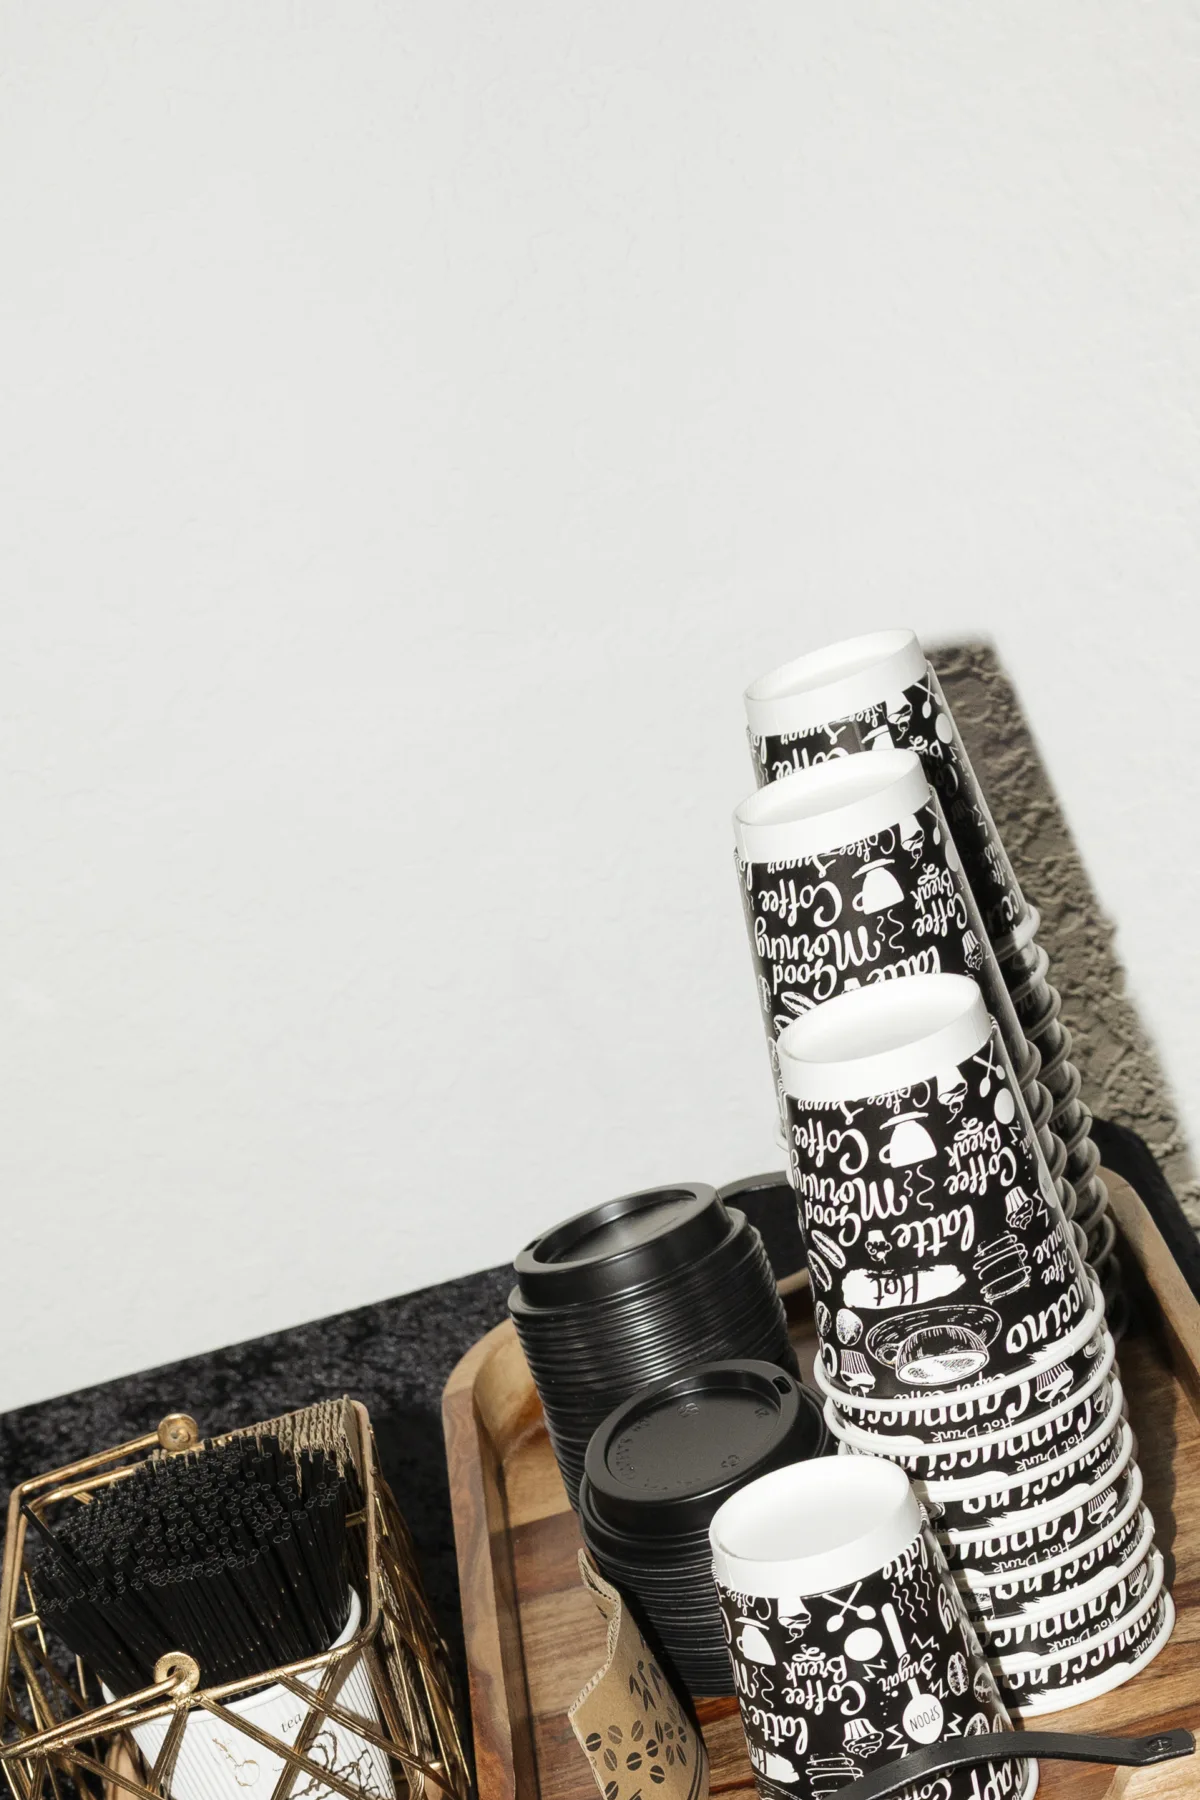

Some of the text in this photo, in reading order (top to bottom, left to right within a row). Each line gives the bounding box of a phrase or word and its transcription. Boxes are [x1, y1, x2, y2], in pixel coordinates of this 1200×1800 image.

[758, 879, 842, 927] Coffee
[910, 867, 955, 911] Break
[912, 893, 967, 937] Coffee
[754, 916, 881, 972] Morning
[771, 956, 838, 1001] Good
[792, 1118, 870, 1175] Coffee
[943, 1119, 1001, 1168] Break
[790, 1149, 909, 1220] Morning
[943, 1147, 1017, 1196] Coffee
[803, 1198, 862, 1247] Good
[891, 1204, 976, 1258] latte
[1032, 1222, 1065, 1264] ouse
[873, 1273, 919, 1308] Hot
[930, 1417, 1015, 1443] Hot Drink
[1014, 1431, 1085, 1472] Hot Drink
[991, 1540, 1071, 1574] Hot Drink
[1046, 1615, 1119, 1653] Hot Drink
[782, 1653, 848, 1686] Break
[877, 1652, 937, 1698] Sugar
[781, 1680, 866, 1717] Coffee
[909, 1703, 941, 1733] SPOON
[280, 1712, 303, 1734] tea
[748, 1705, 809, 1756] latte
